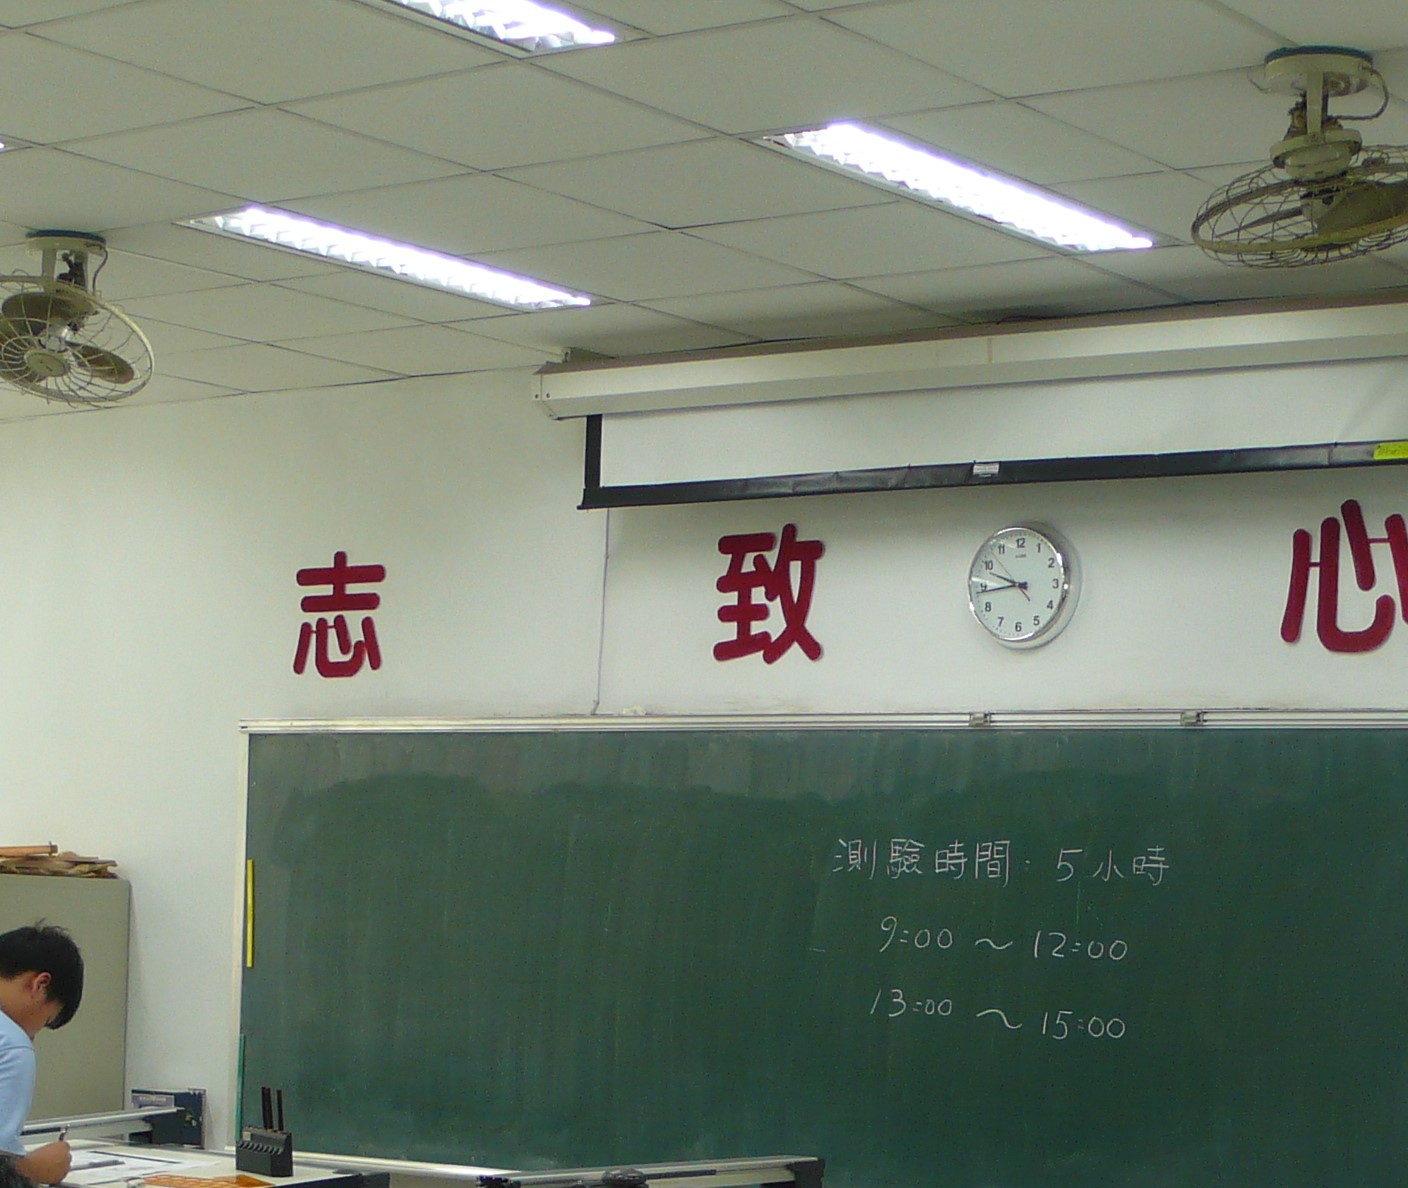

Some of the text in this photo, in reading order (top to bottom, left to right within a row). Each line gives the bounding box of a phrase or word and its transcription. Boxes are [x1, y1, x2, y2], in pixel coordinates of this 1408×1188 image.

[1016, 537, 1026, 549] 12
[997, 544, 1006, 555] 11
[984, 560, 994, 571] 10
[1047, 557, 1055, 569] 2
[1052, 578, 1059, 589] 3
[713, 523, 824, 664] 致
[984, 601, 992, 612] 8
[1046, 600, 1054, 610] 4
[293, 551, 386, 678] 志
[997, 616, 1004, 627] 7
[1033, 615, 1041, 626] 5
[1014, 621, 1022, 632] 6
[879, 916, 954, 953] 9:00
[1032, 929, 1129, 961] 12:00
[870, 988, 953, 1018] 13:00
[1041, 1010, 1127, 1041] 15:00
